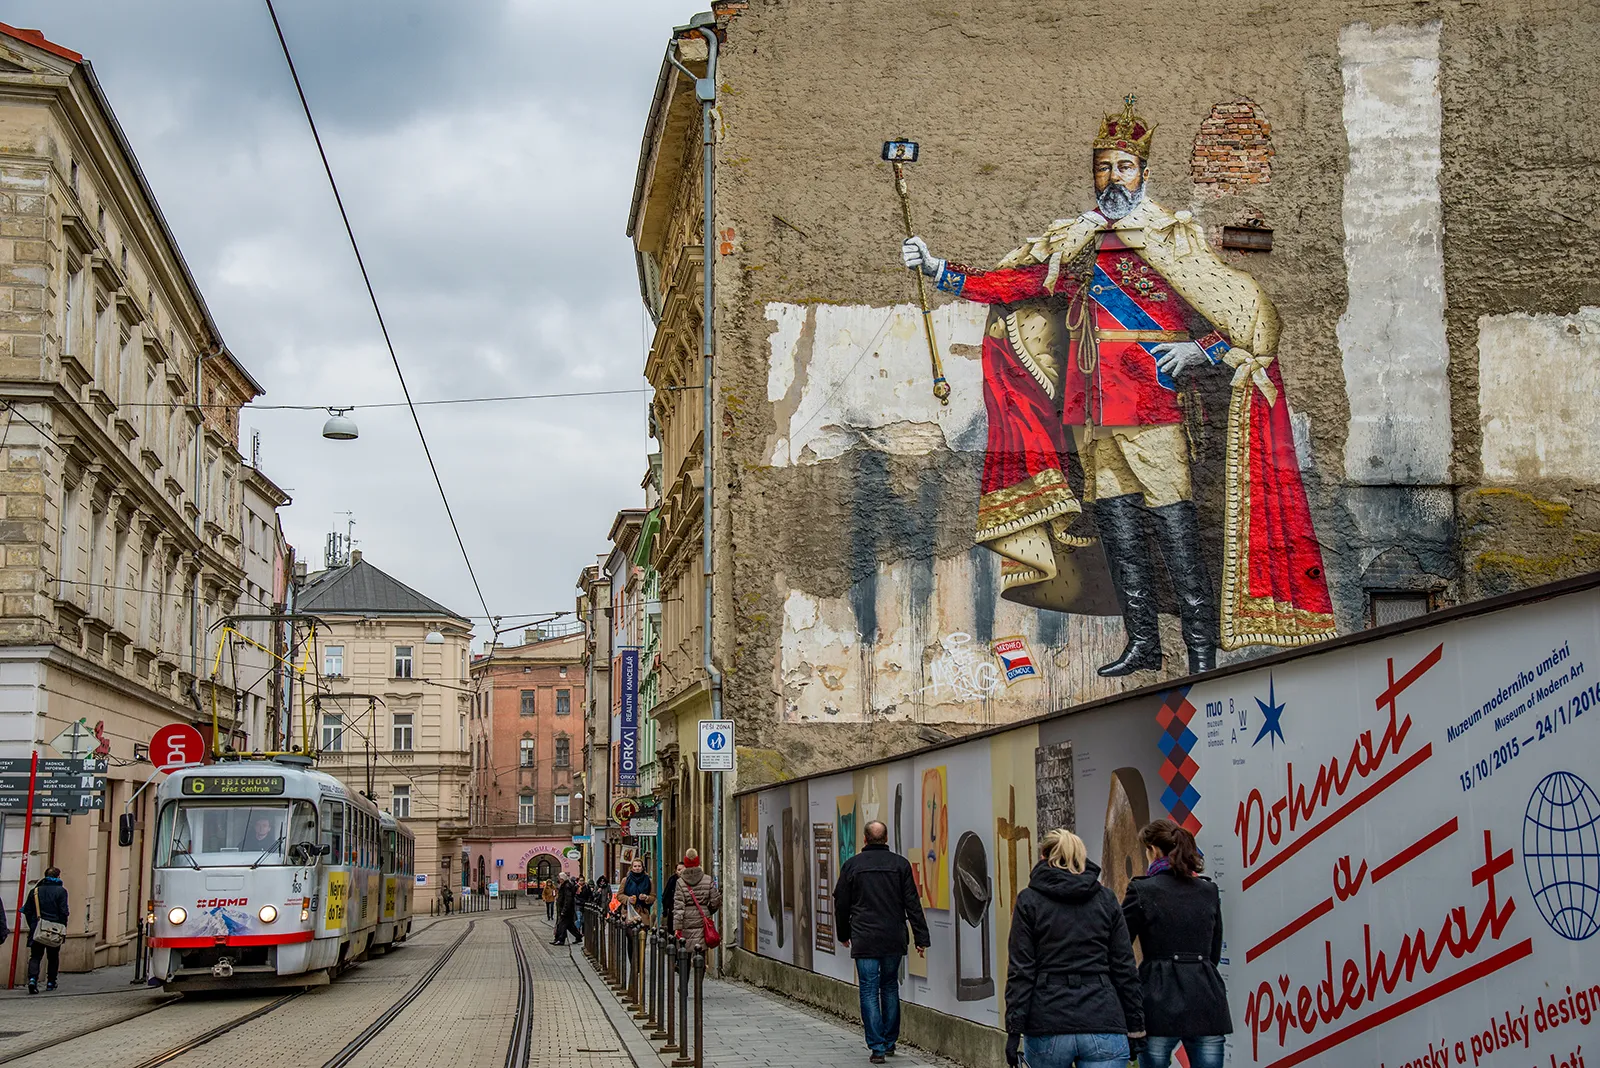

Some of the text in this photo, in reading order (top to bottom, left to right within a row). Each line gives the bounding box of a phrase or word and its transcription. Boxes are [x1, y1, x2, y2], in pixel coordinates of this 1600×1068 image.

[1447, 640, 1571, 742] Muzeum moderního umění
[1494, 662, 1584, 732] Museum of Modern Art
[622, 731, 634, 770] ORKA
[1234, 642, 1444, 868] Dohnat
[1460, 737, 1520, 792] 15/10/2015
[192, 778, 205, 793] 6
[221, 785, 238, 793] přes
[292, 883, 302, 893] 168
[1333, 855, 1368, 901] a
[1245, 830, 1516, 1062] Předehnat
[1455, 1041, 1467, 1064] a
[1470, 1005, 1529, 1067] polský
[1534, 985, 1600, 1033] design
